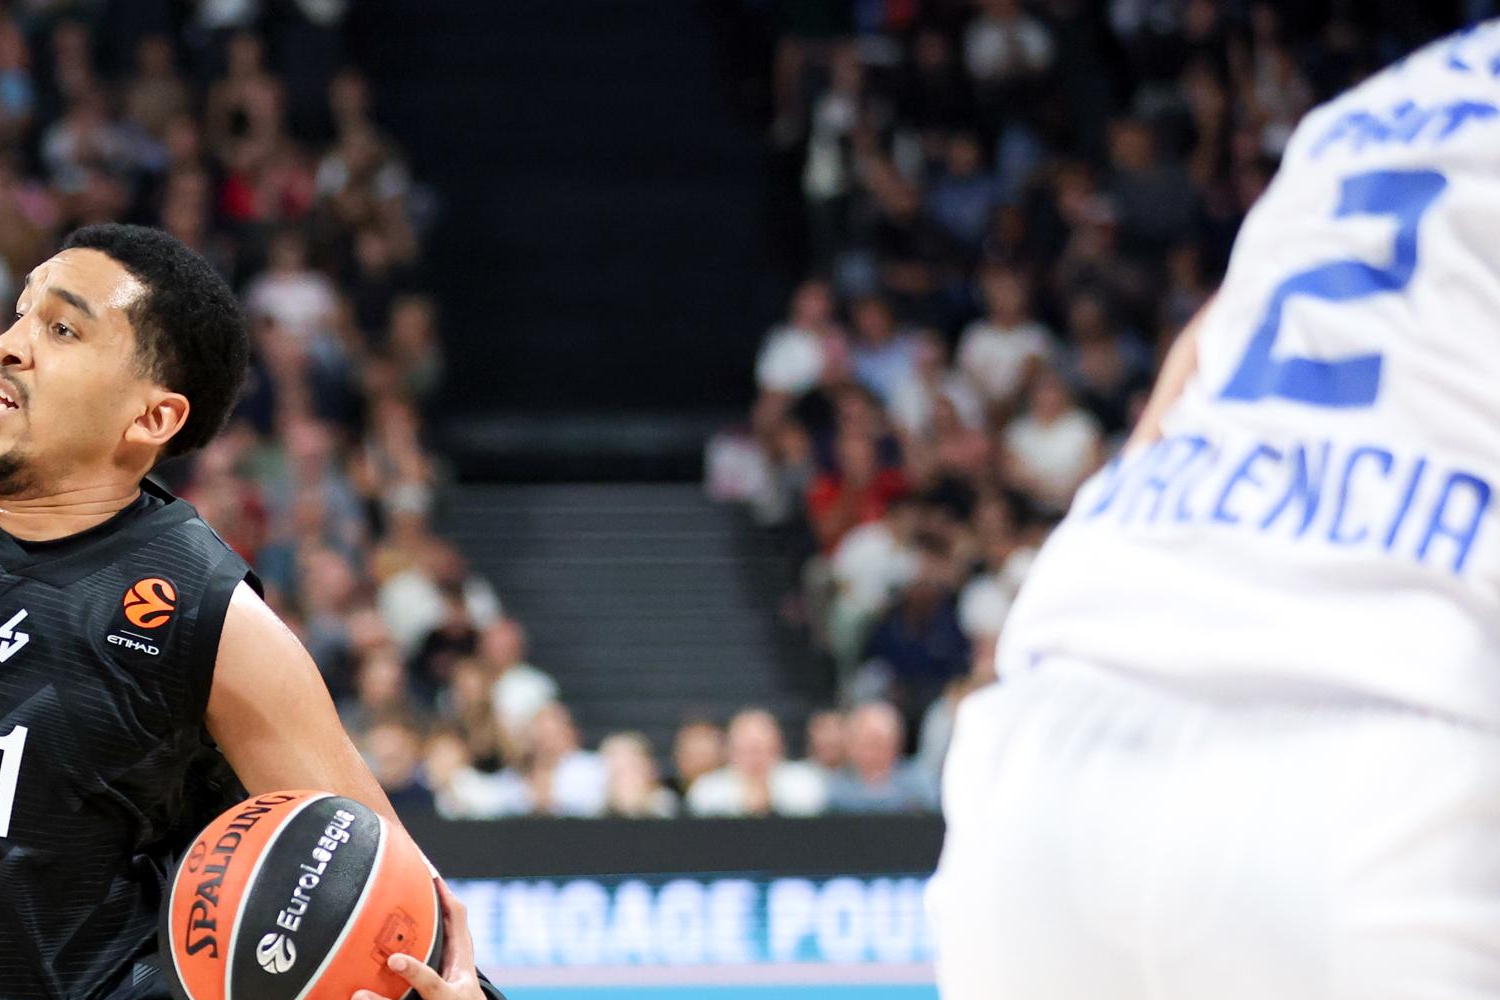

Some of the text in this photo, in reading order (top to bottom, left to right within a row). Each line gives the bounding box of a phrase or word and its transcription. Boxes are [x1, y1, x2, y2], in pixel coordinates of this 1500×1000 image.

[1213, 167, 1448, 408] 2
[106, 634, 160, 656] ETIHAD
[186, 794, 297, 960] SPALDING
[768, 879, 926, 963] POU
